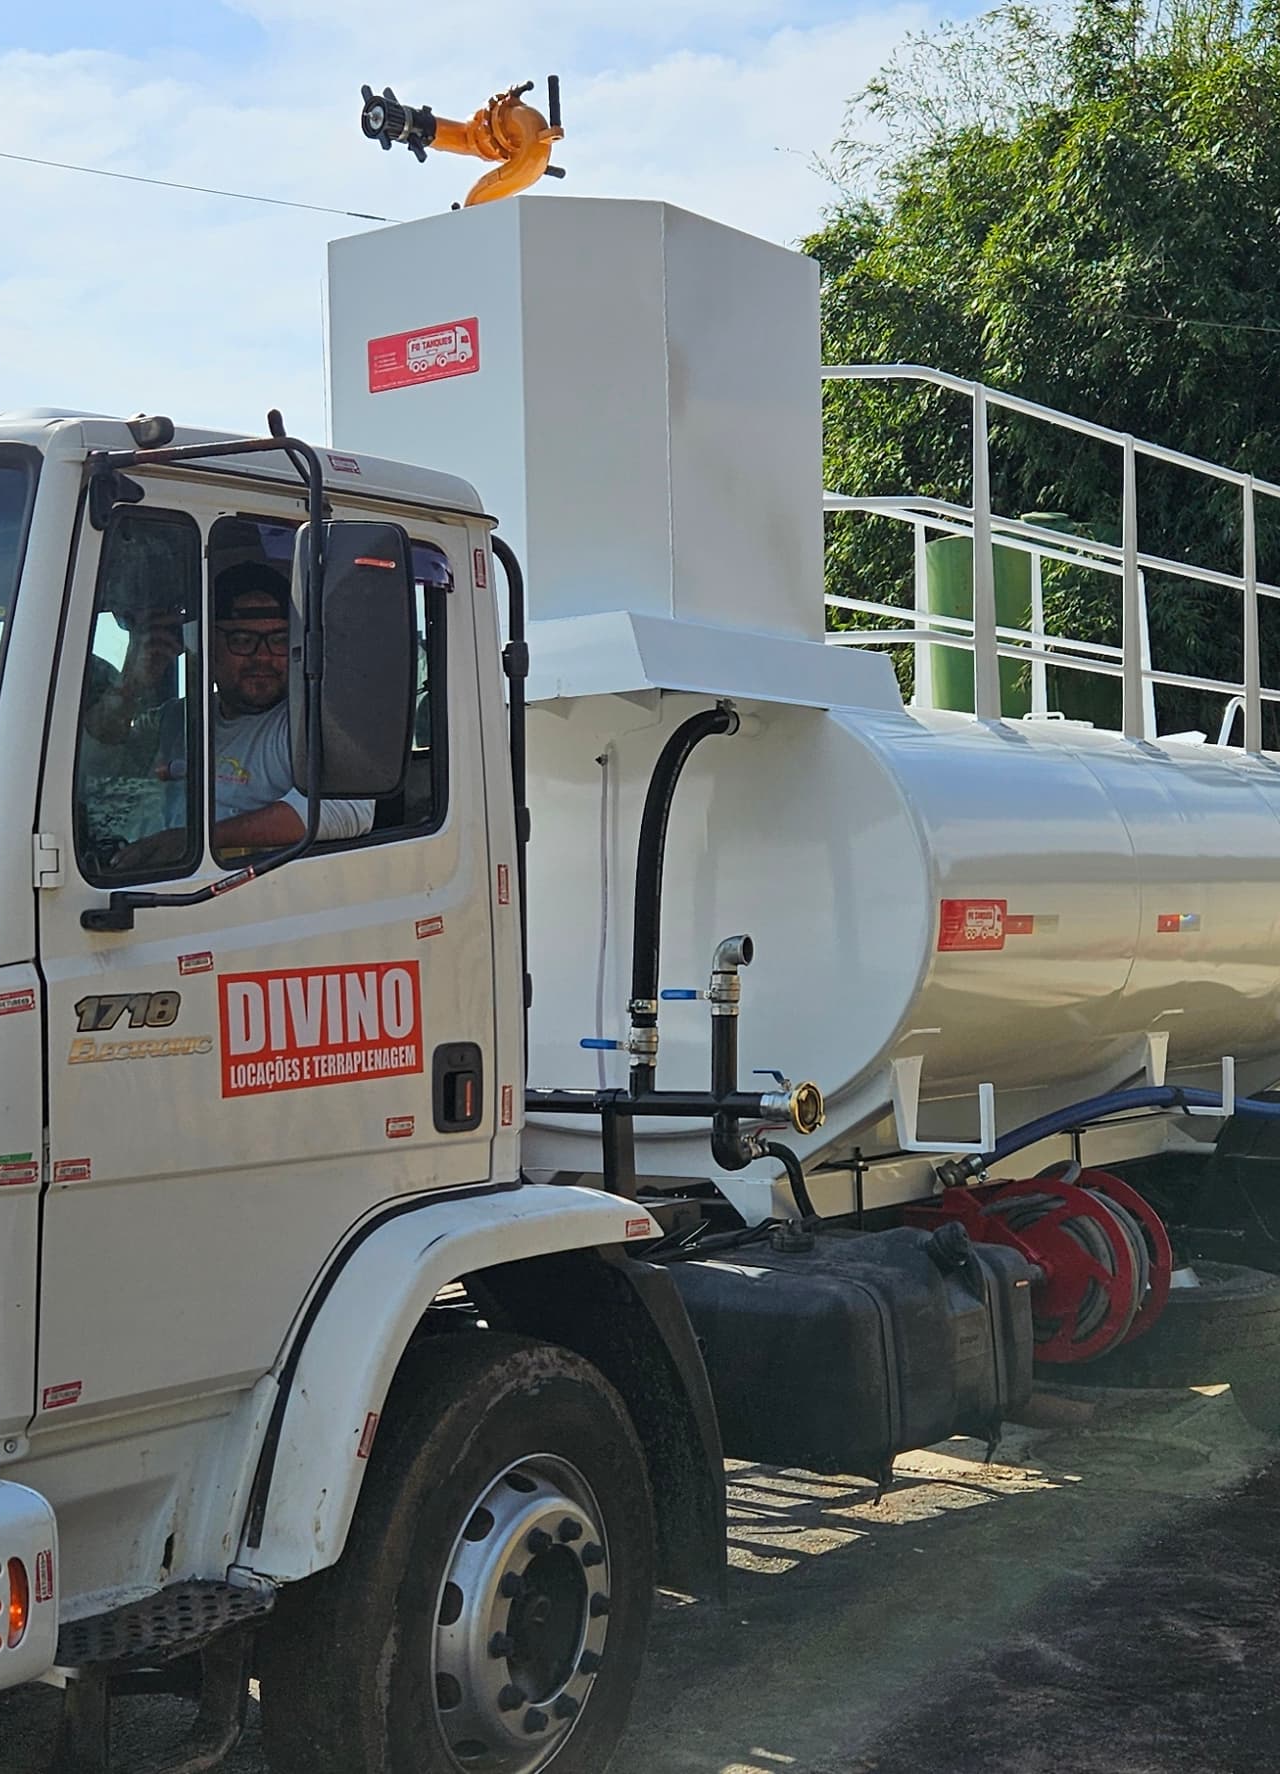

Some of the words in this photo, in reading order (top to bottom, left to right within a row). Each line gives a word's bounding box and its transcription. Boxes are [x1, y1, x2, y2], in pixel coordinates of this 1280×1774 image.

[74, 991, 181, 1032] 1718
[227, 967, 415, 1056] DIVINO
[230, 1056, 301, 1089] LOCAÇÕES
[302, 1057, 311, 1080] E
[312, 1045, 417, 1079] TERRAPLENAGEM
